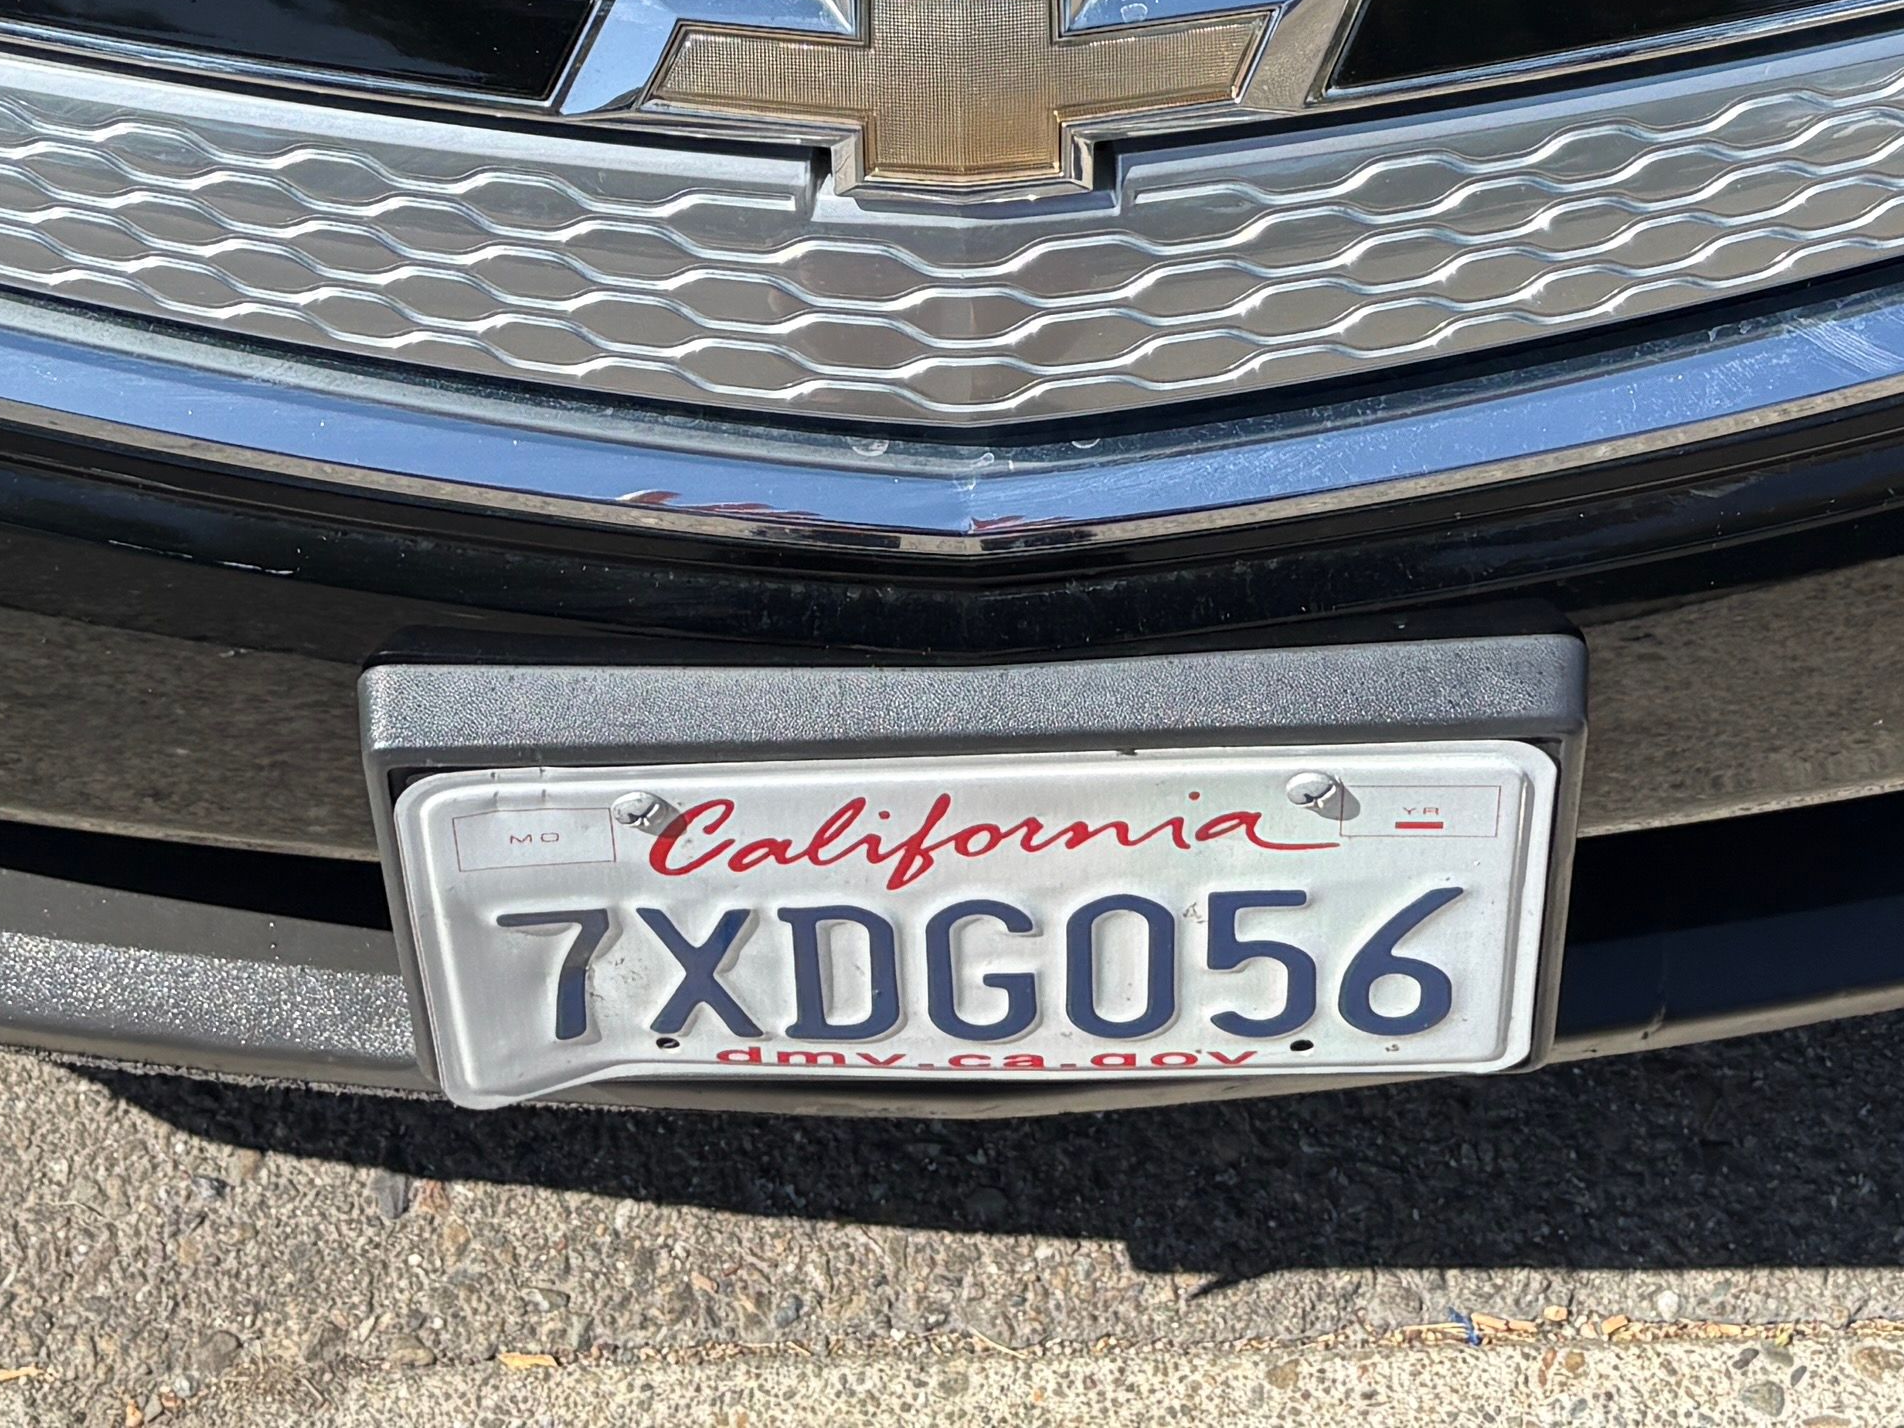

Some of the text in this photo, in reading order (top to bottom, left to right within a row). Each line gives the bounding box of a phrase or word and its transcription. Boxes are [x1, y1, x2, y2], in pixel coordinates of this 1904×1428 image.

[1402, 806, 1439, 816] YR
[510, 832, 560, 845] MO
[647, 791, 1340, 892] California
[496, 886, 1466, 1043] 7XDG056
[715, 1046, 1258, 1070] dmv.ca.gov
